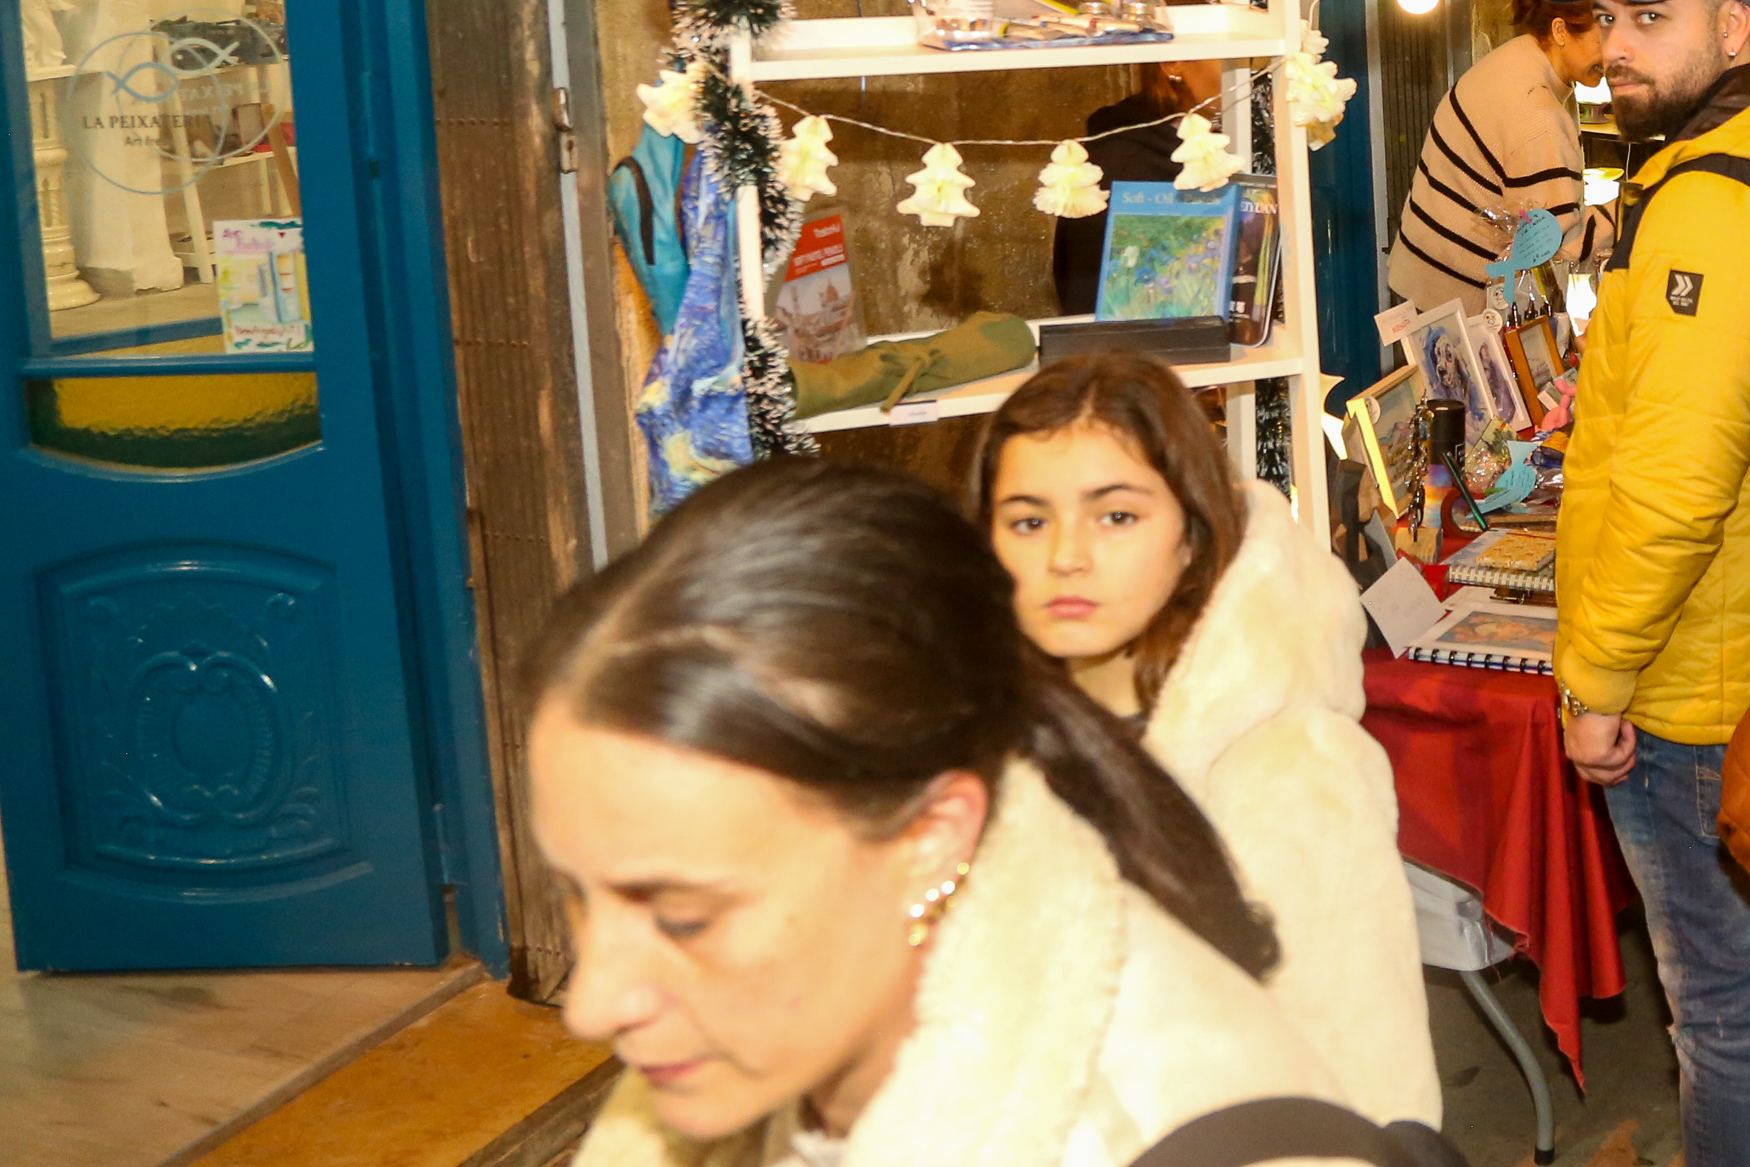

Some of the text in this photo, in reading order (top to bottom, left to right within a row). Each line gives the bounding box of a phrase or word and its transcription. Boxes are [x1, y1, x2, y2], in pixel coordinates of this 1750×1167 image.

[83, 113, 214, 130] LA PEIXATERIA
[124, 135, 142, 147] Art
[1121, 191, 1146, 204] Soft
[1154, 191, 1174, 205] Oil
